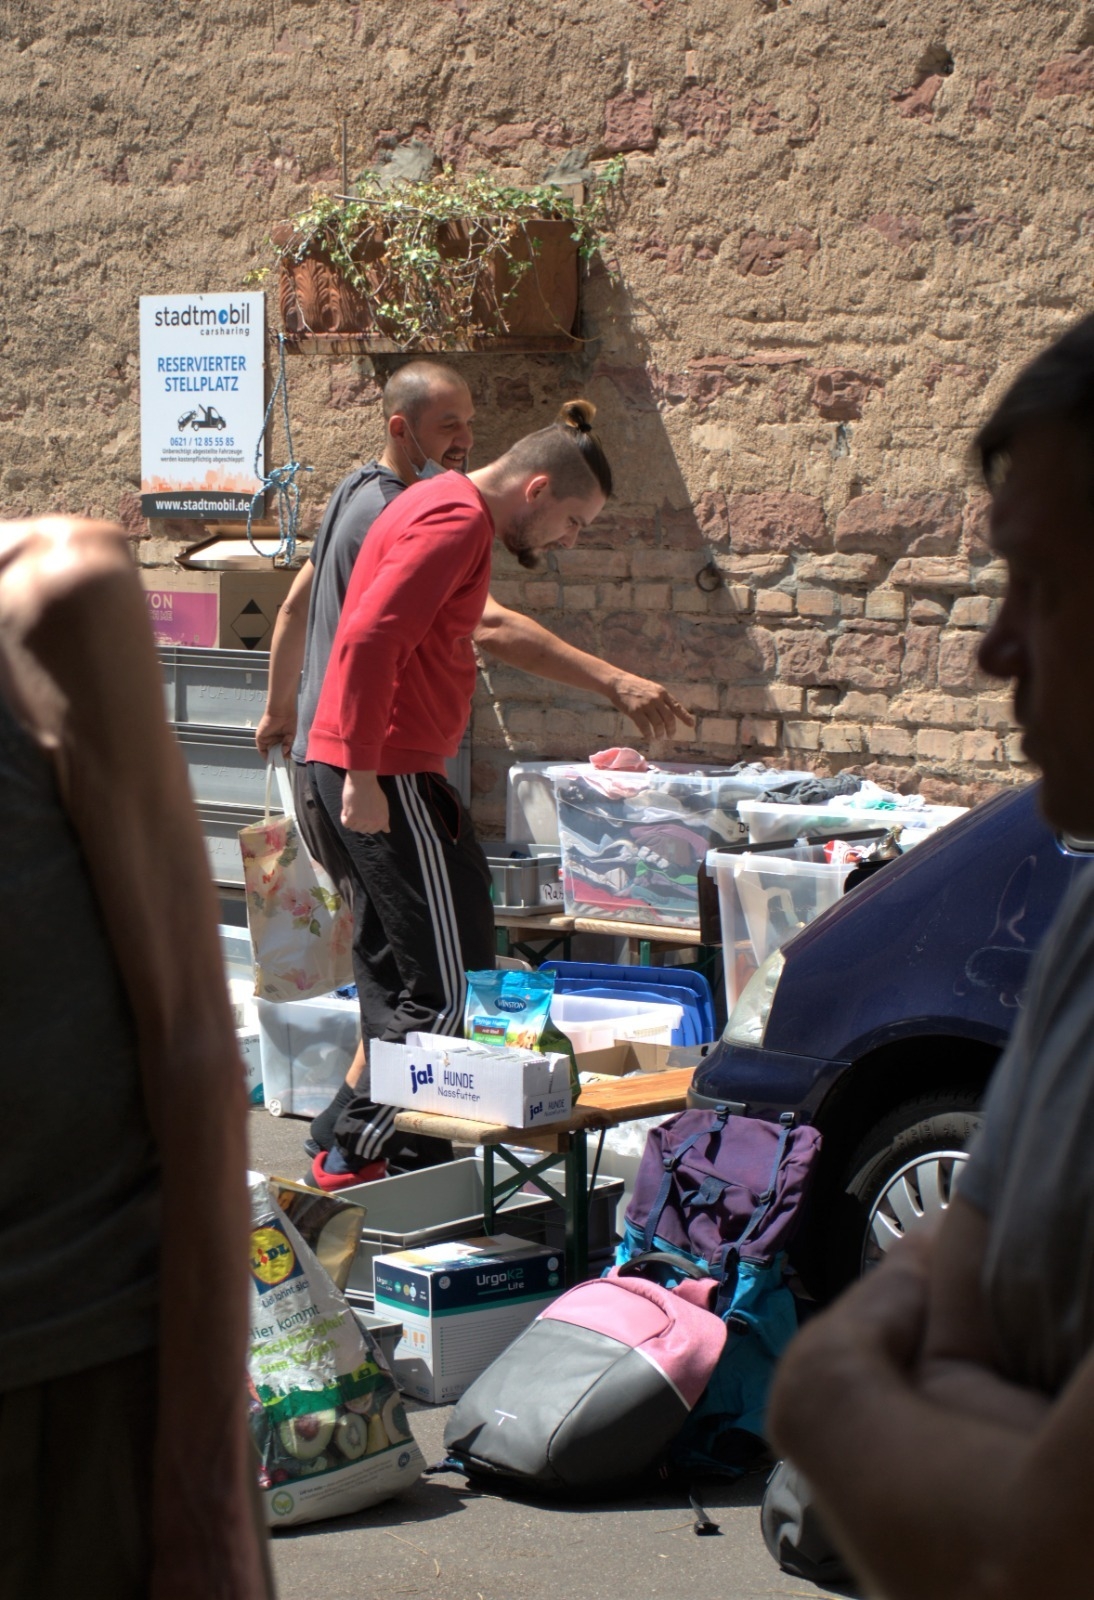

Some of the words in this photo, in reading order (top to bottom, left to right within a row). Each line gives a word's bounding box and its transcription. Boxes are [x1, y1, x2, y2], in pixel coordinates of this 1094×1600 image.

[155, 303, 250, 327] stadtmobil
[200, 327, 250, 337] carsharing
[157, 356, 247, 373] RESERVIERTER
[164, 376, 239, 392] STELLPLATZ
[170, 437, 187, 447] 0621
[194, 437, 203, 447] 12
[204, 437, 213, 447] 85
[215, 437, 224, 447] 55
[225, 437, 234, 447] 85
[155, 498, 250, 512] www.stadtmobil.de
[497, 999, 525, 1010] WINSTON
[410, 1063, 434, 1094] ja!
[443, 1070, 475, 1090] HUNDE
[437, 1086, 481, 1103] Nassfutter
[529, 1101, 543, 1120] ja!
[548, 1098, 565, 1110] HUNDE
[476, 1268, 524, 1287] UrgoK2
[507, 1281, 525, 1291] Lite
[275, 1303, 320, 1332] kommt
